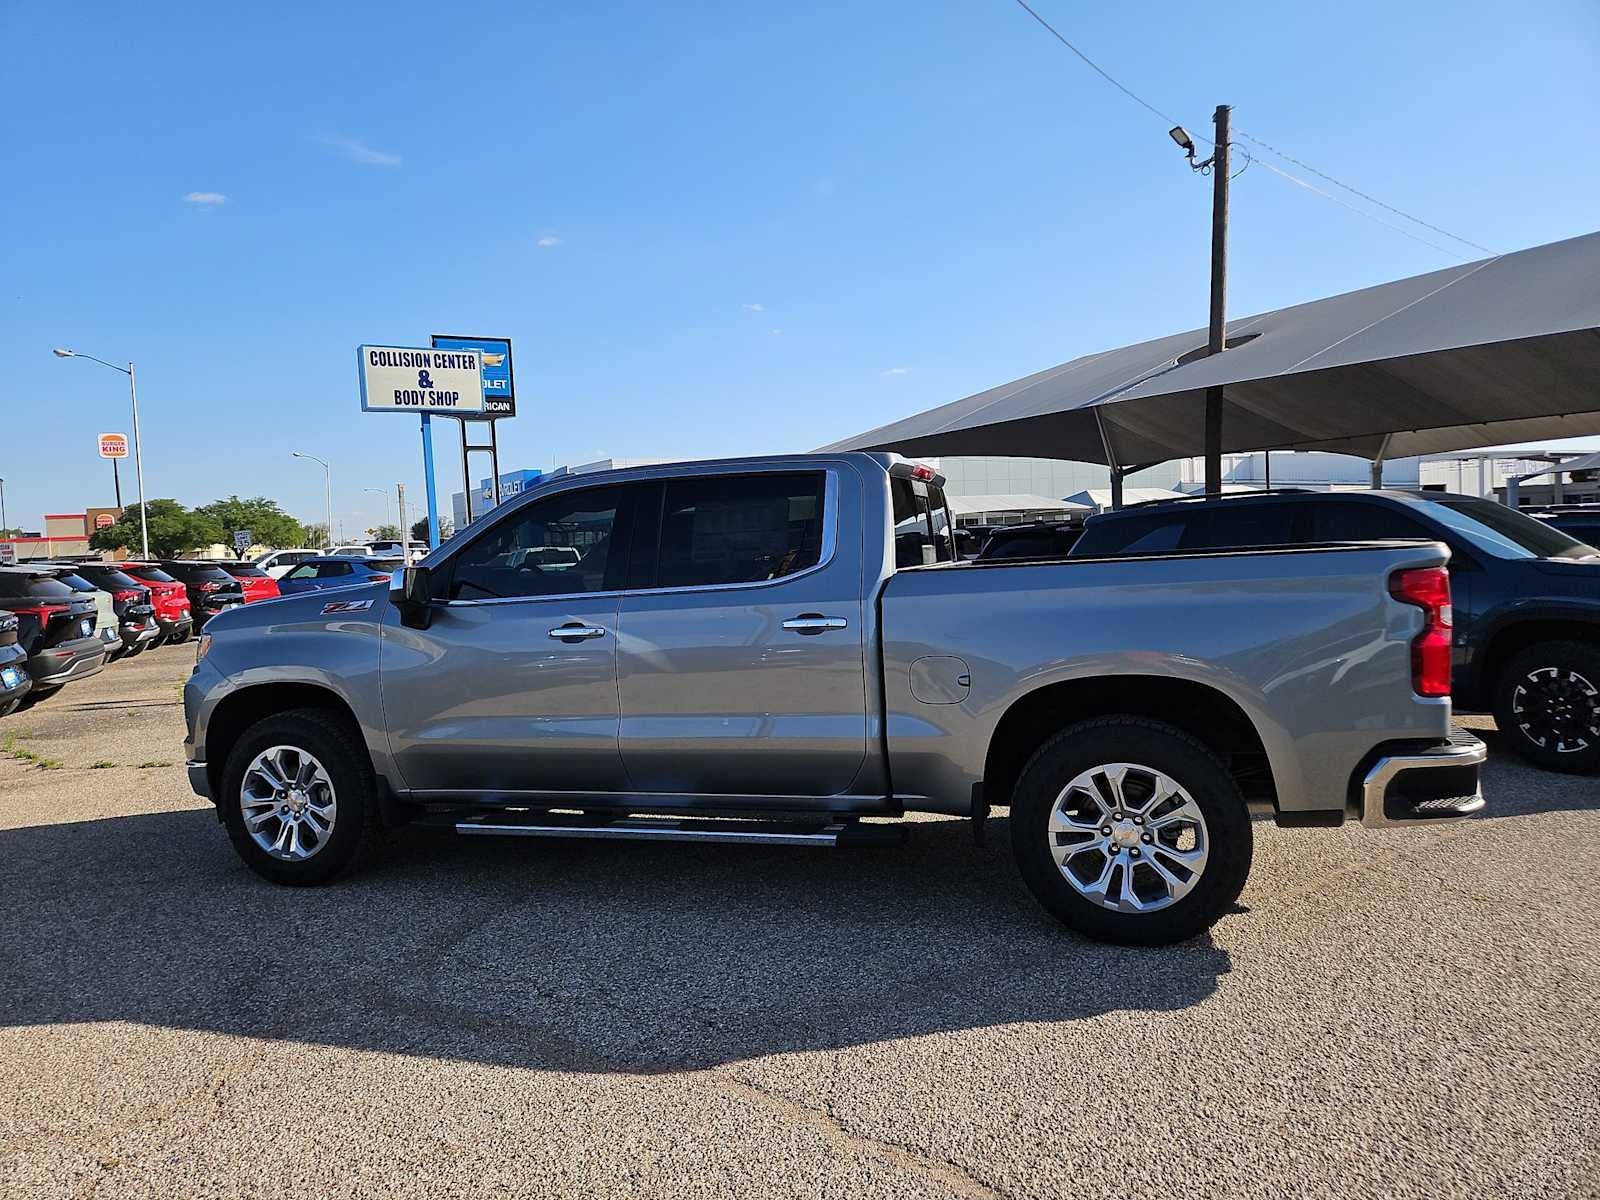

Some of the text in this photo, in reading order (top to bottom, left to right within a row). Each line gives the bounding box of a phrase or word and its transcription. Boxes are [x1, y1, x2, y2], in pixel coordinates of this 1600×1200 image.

[370, 351, 476, 370] COLLISION CENTER
[418, 369, 434, 389] &
[394, 390, 459, 406] BODY SHOP
[320, 599, 376, 616] Z71
